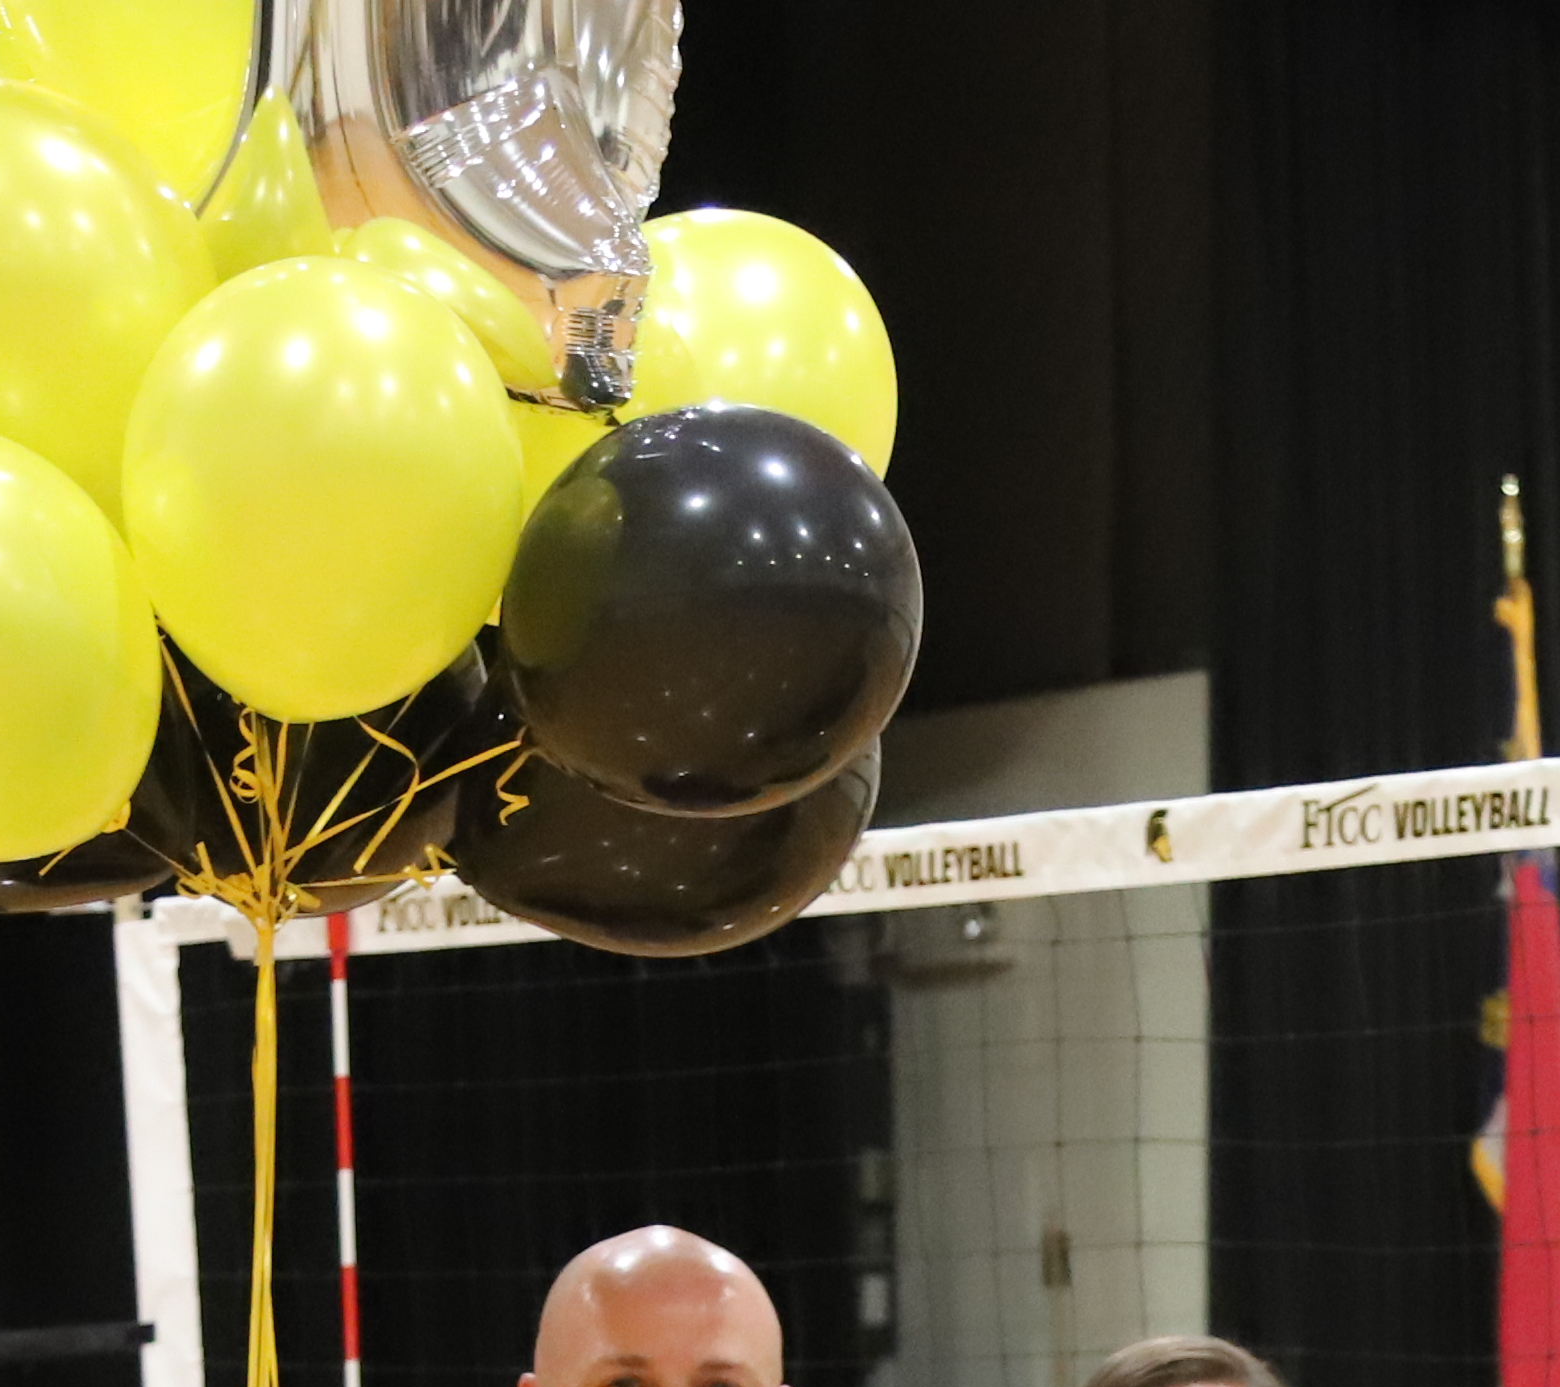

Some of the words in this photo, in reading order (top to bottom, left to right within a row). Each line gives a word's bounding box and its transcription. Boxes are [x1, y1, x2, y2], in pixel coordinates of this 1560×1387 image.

[1301, 784, 1382, 849] FTCC
[1395, 786, 1552, 841] VOLLEYBALL
[883, 841, 1024, 888] VOLLEYBALL
